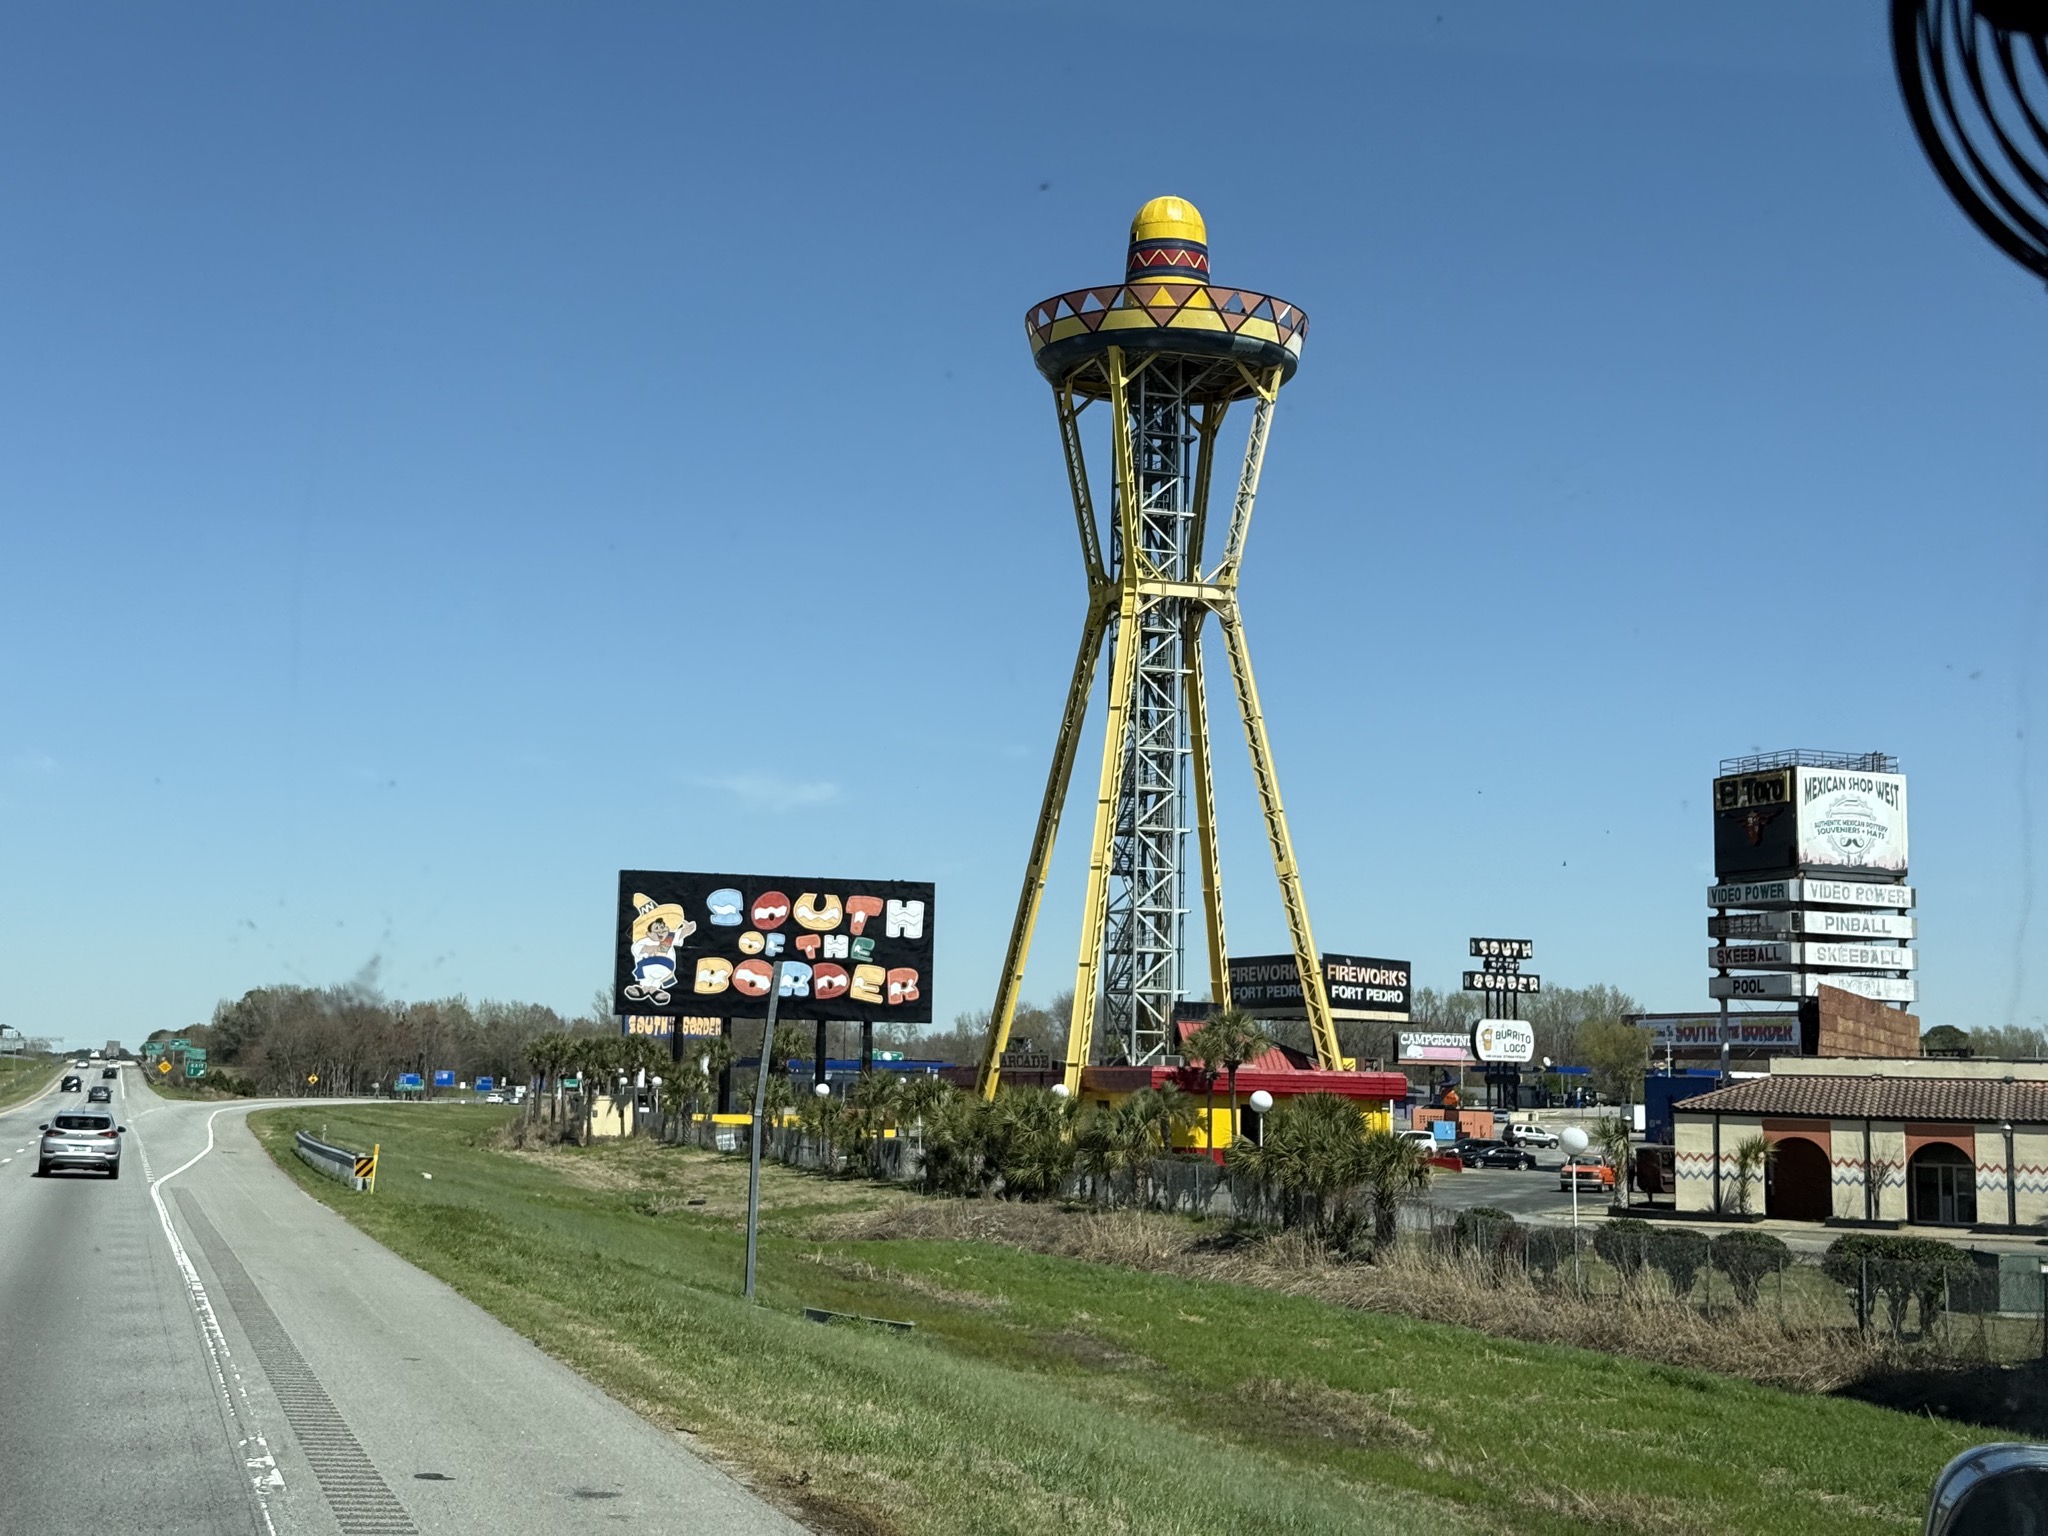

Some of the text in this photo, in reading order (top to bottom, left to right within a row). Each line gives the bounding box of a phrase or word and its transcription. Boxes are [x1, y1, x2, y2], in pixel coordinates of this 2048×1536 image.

[1804, 776, 1899, 811] MEXICAN SHOP WEST
[1842, 819, 1865, 828] MEXICAN
[1866, 821, 1888, 833] POTTERY
[1866, 828, 1885, 840] HATS
[1711, 882, 1785, 902] VIDEO POWER
[1810, 882, 1906, 904] VIDEO POWER
[706, 888, 925, 939] SOUTH
[1825, 915, 1892, 934] PINBALL
[738, 931, 875, 962] OF THE
[1479, 940, 1532, 957] SOUTH
[1717, 946, 1782, 964] SKEEBALL
[1817, 946, 1903, 965] SKEEBALL
[694, 957, 919, 1005] BORDER
[1229, 964, 1300, 983] FIREWORK
[1327, 963, 1407, 987] FIREWORKS
[1473, 973, 1538, 991] BORDER
[1233, 986, 1264, 1000] FORT
[1331, 984, 1404, 1004] FORT PEDRO
[1732, 979, 1765, 994] POOL
[628, 1015, 668, 1036] SOUTH
[1675, 1019, 1717, 1042] SOUTH
[1741, 1018, 1793, 1042] BORDER
[1400, 1033, 1471, 1047] CAMPGROUN
[1504, 1043, 1526, 1053] LOCO
[1001, 1054, 1049, 1068] ARCADE
